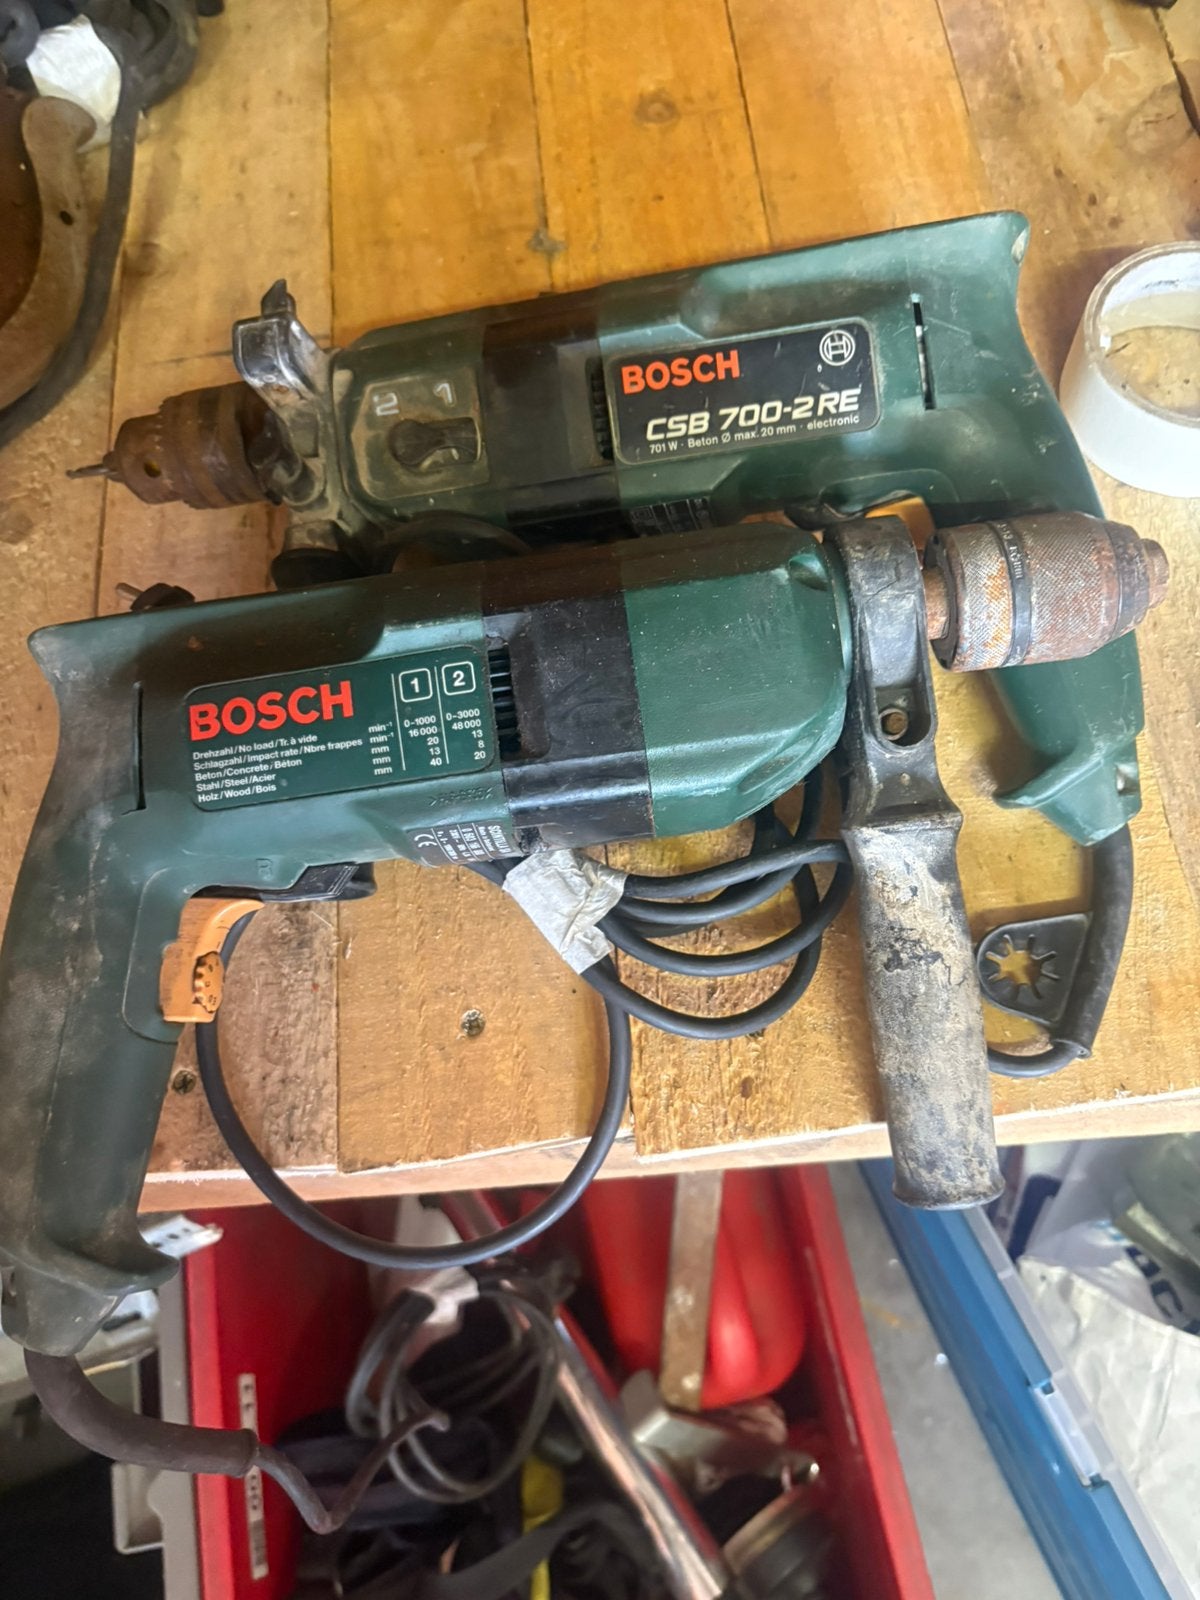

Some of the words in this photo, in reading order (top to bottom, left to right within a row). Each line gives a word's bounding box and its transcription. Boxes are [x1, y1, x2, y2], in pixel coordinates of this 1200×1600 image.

[621, 349, 740, 395] BOSCH
[372, 392, 399, 417] 2
[435, 383, 452, 405] 1
[646, 411, 711, 441] CSB
[649, 442, 667, 455] 701
[668, 440, 678, 452] W
[687, 435, 719, 449] Beton
[734, 429, 760, 441] max.
[761, 426, 774, 438] 20
[776, 424, 797, 435] mm
[806, 413, 860, 431] electronic
[410, 676, 421, 694] 1
[452, 670, 466, 688] 2
[188, 680, 354, 742] BOSCH
[290, 736, 297, 745] à
[298, 734, 318, 744] vide
[403, 715, 437, 728] 0-1000
[445, 708, 480, 721] 0-3000
[327, 738, 363, 750] frappes
[371, 745, 390, 755] mm
[427, 736, 440, 746] 20
[471, 729, 484, 739] 13
[372, 755, 391, 765] mm
[429, 746, 441, 756] 13
[477, 739, 485, 749] 8
[374, 766, 393, 776] mm
[430, 757, 443, 767] 40
[473, 750, 486, 760] 20
[414, 833, 437, 848] CE
